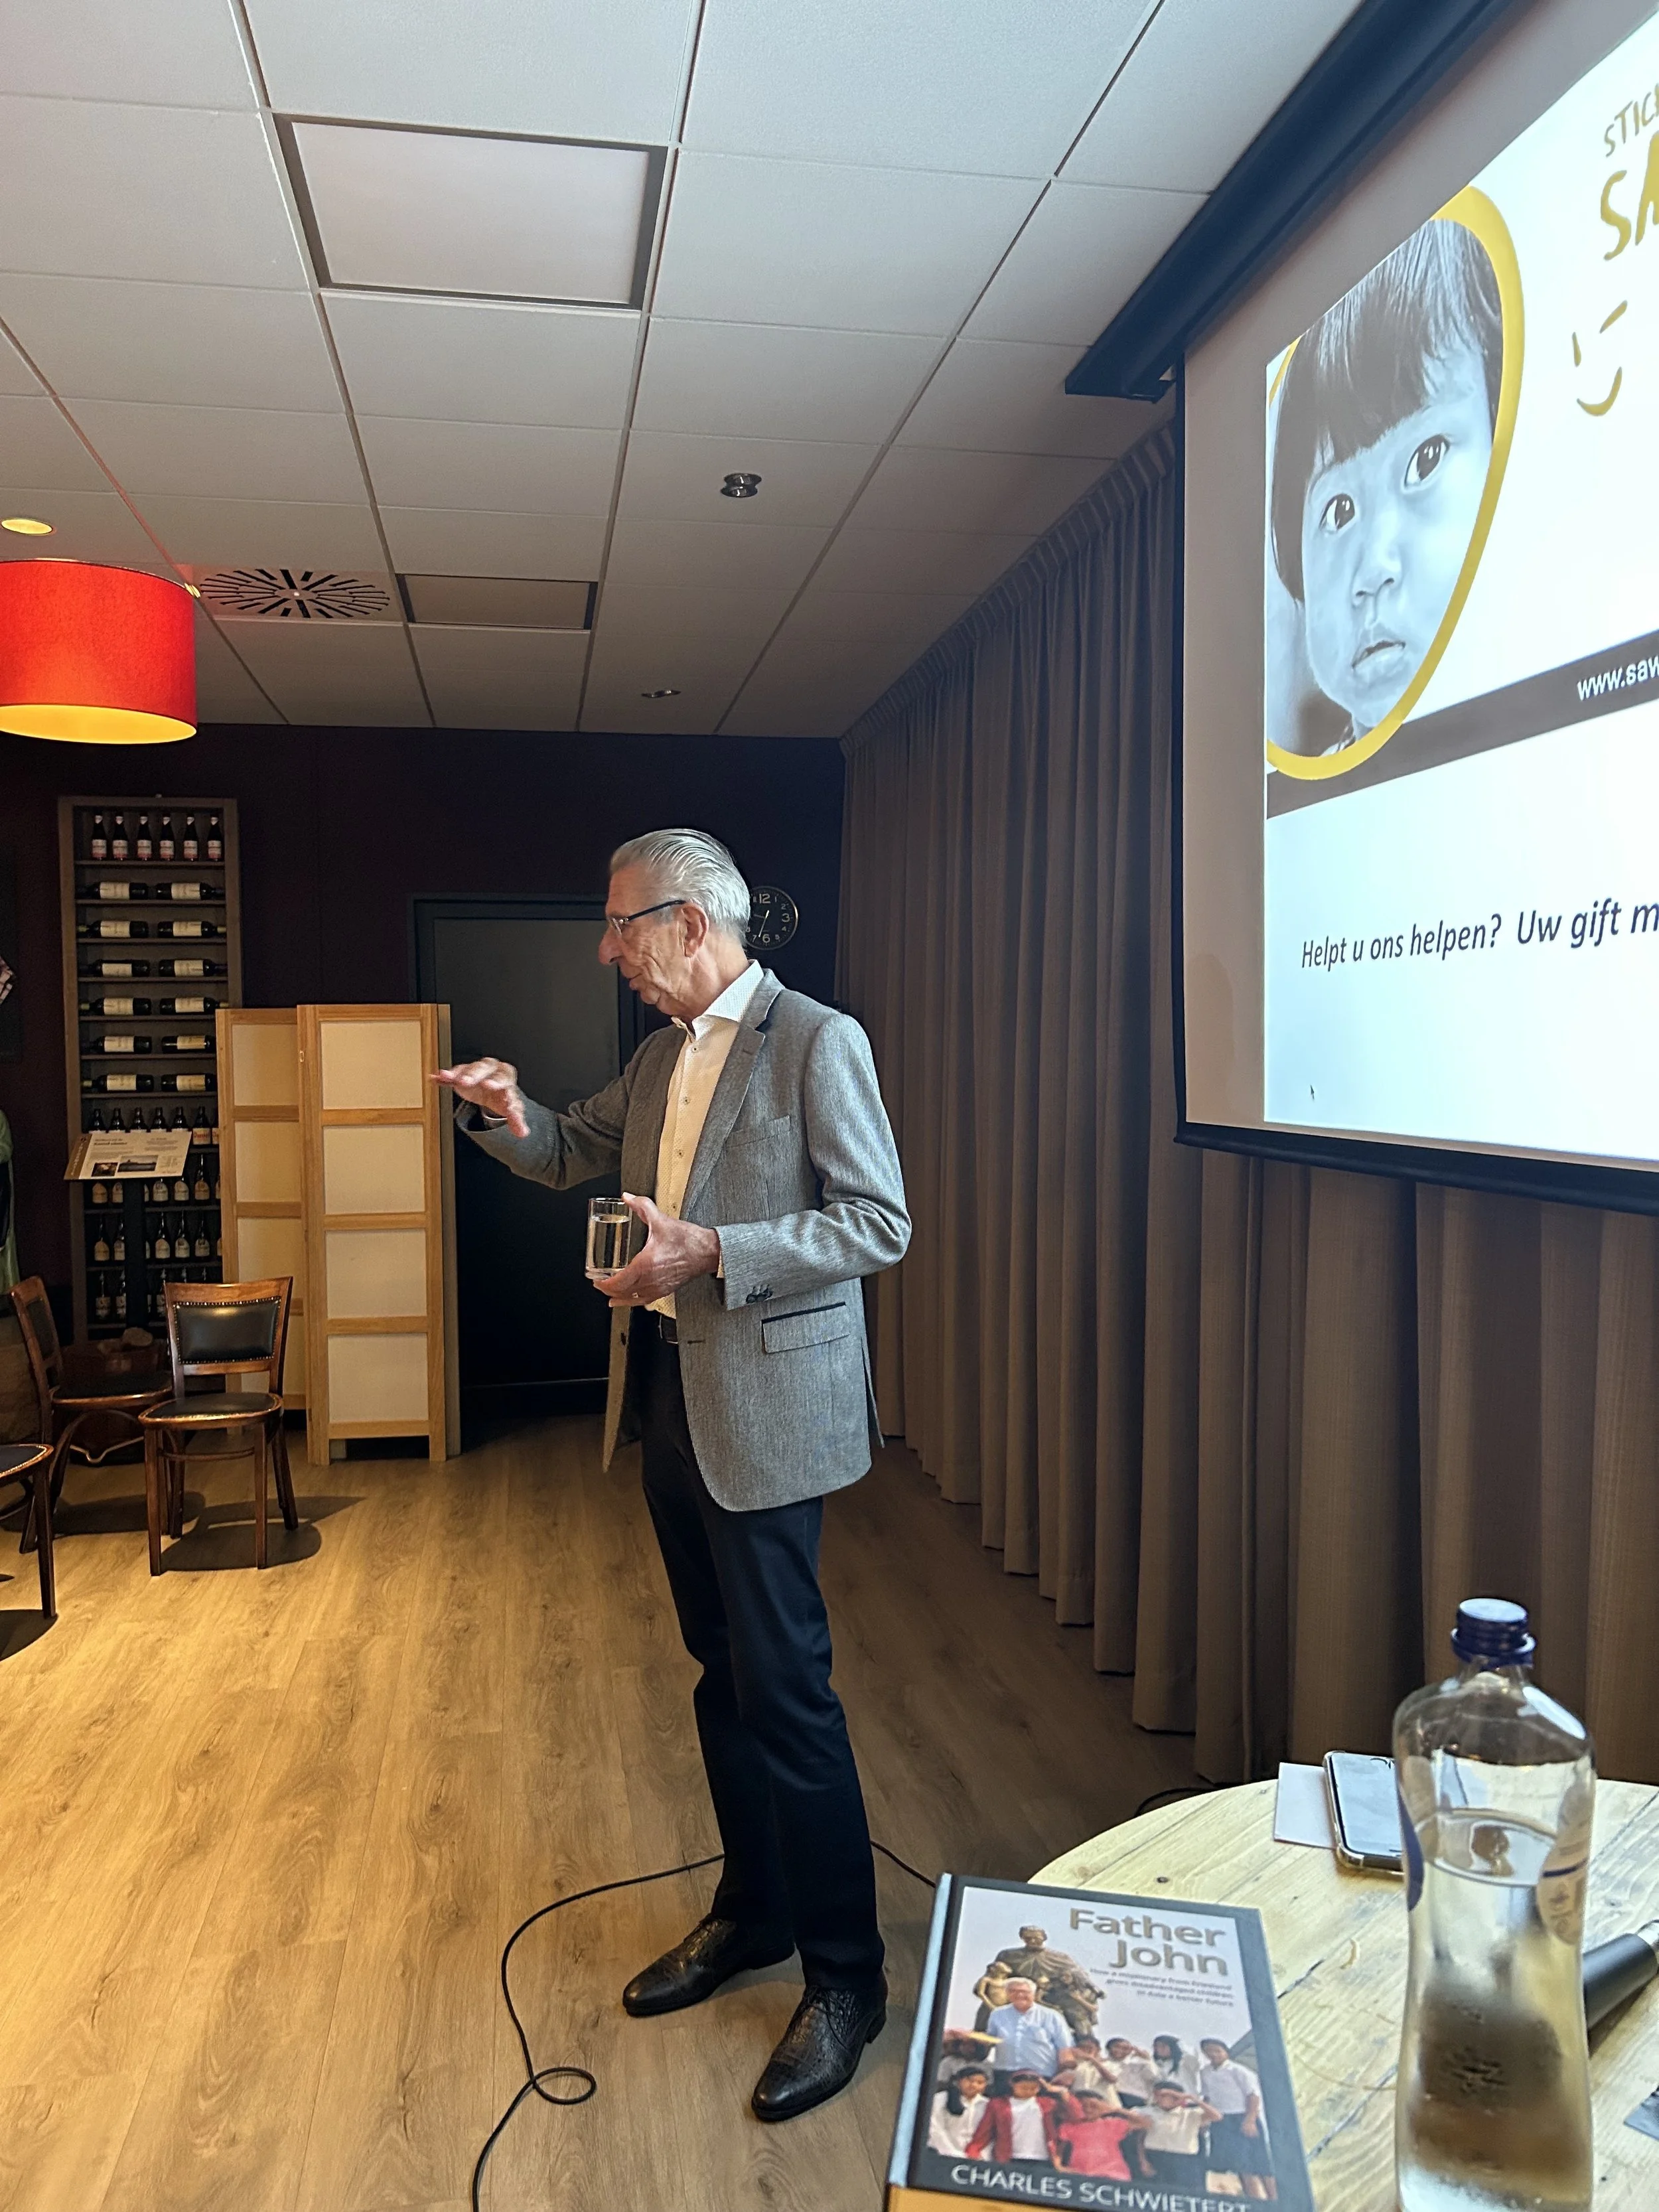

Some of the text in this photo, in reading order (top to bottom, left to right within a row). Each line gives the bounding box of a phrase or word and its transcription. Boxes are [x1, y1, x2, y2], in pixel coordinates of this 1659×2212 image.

[758, 893, 771, 904] 12
[781, 913, 790, 922] 3
[1302, 935, 1346, 972] Helpt
[1352, 940, 1364, 962] u
[1370, 934, 1404, 960] ons
[1409, 913, 1502, 961] helpen?
[1518, 910, 1562, 944] Uw
[1571, 897, 1622, 948] gift
[762, 934, 770, 943] 6
[1070, 1907, 1226, 1947] Father
[1109, 1939, 1228, 1976] John
[951, 2164, 1072, 2200] CHARLES
